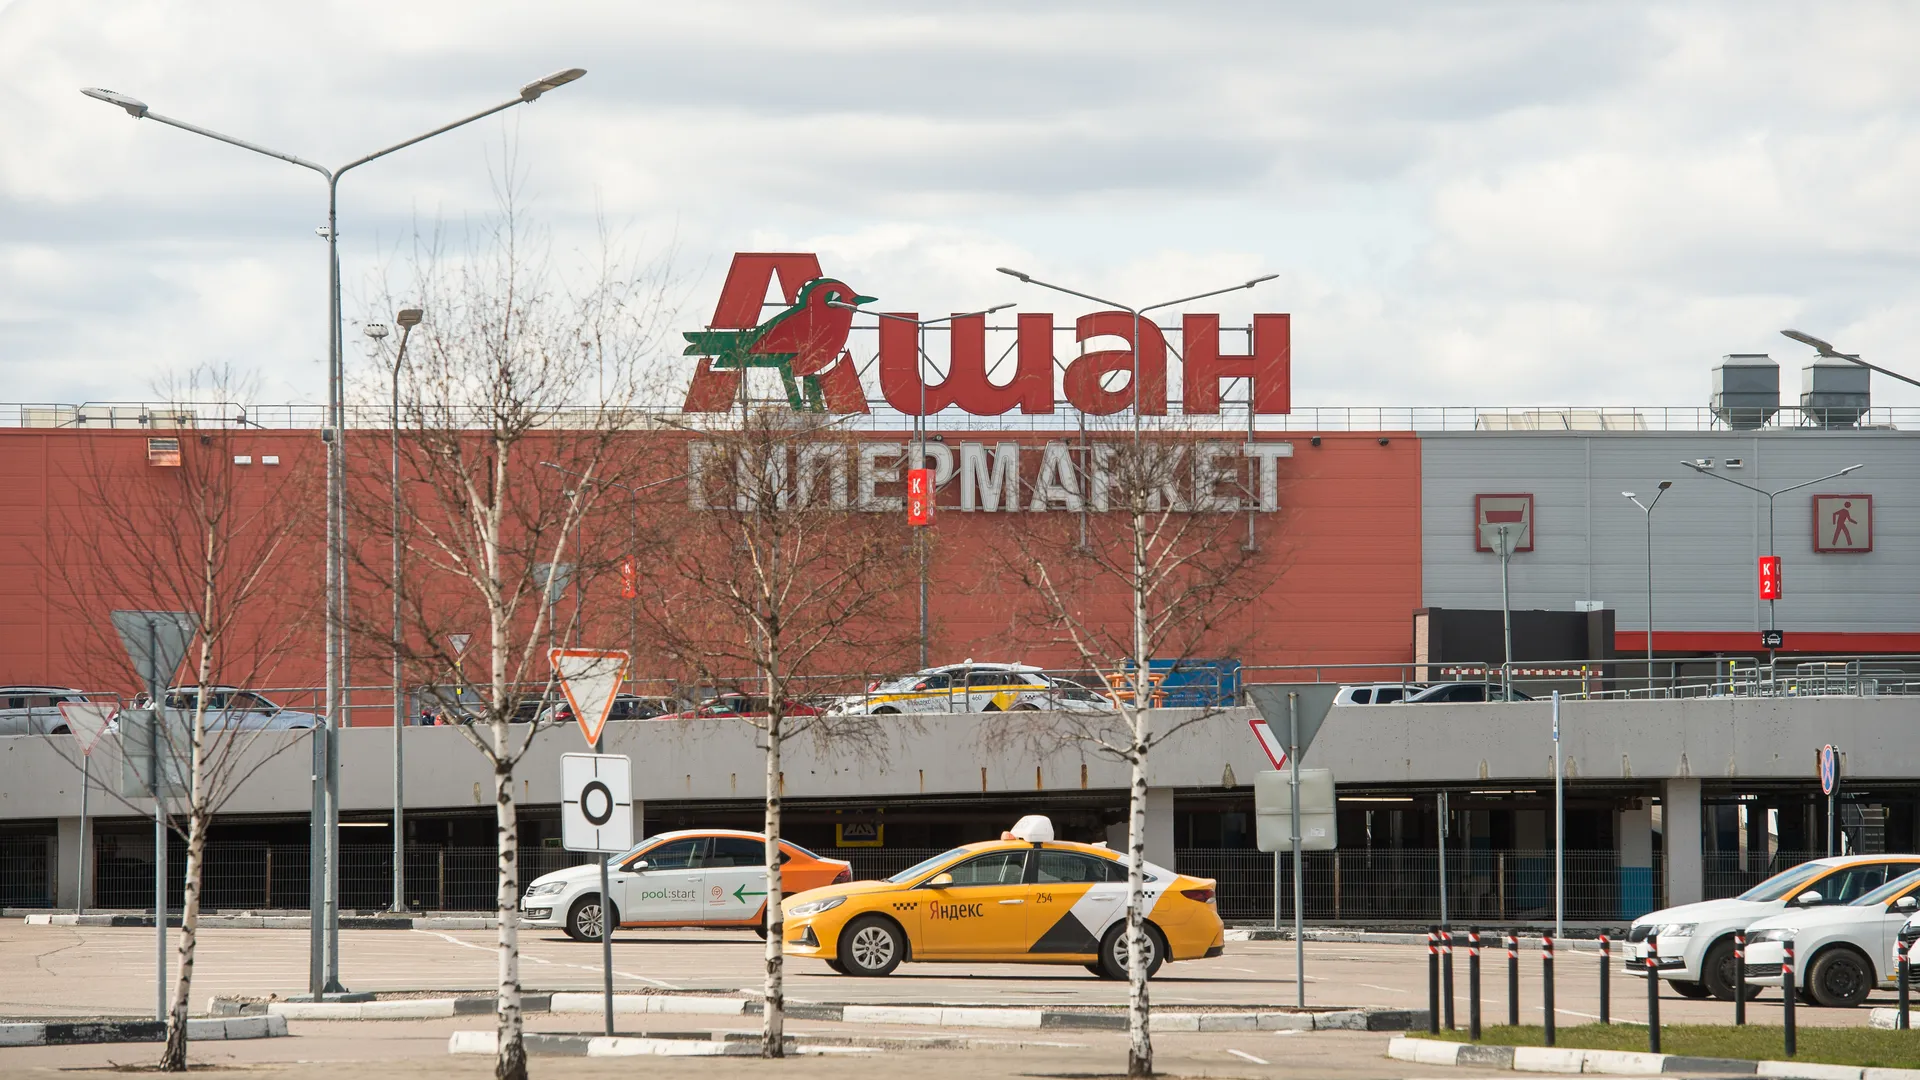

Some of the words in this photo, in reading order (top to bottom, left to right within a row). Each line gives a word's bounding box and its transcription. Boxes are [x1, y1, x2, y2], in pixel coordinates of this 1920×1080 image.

[914, 501, 921, 516] 8
[1764, 581, 1771, 593] 2
[641, 887, 696, 901] pool:start
[1036, 892, 1053, 904] 254
[930, 900, 984, 920] Яндекс
